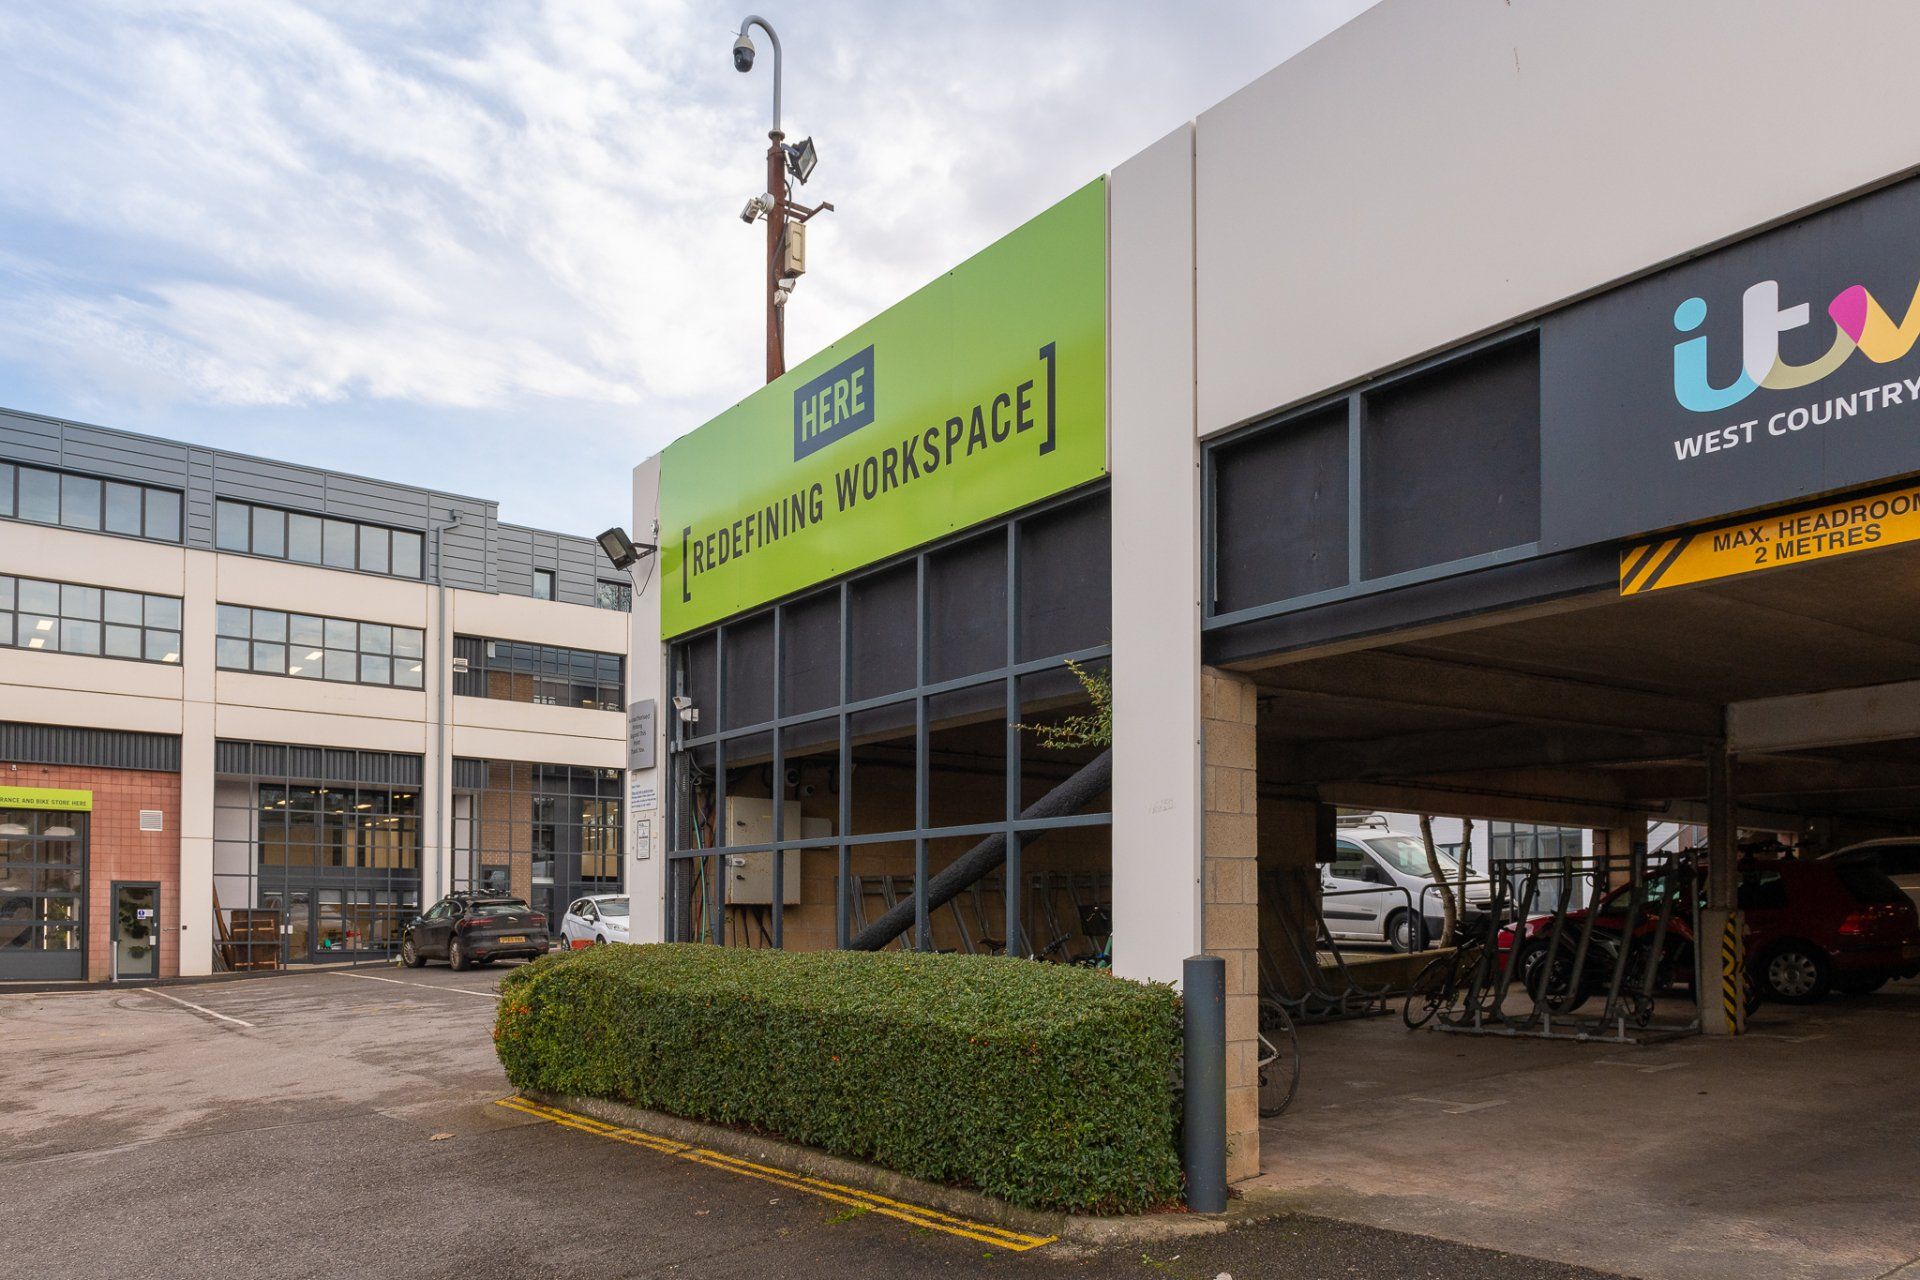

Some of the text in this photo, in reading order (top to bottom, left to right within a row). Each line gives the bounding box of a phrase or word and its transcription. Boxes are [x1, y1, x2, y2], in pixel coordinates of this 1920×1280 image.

[801, 367, 865, 443] HERE
[1674, 376, 1920, 461] WEST COUNTRY
[1713, 526, 1770, 553] MAX.
[1754, 523, 1882, 564] 2 METRES
[52, 799, 70, 807] STORE
